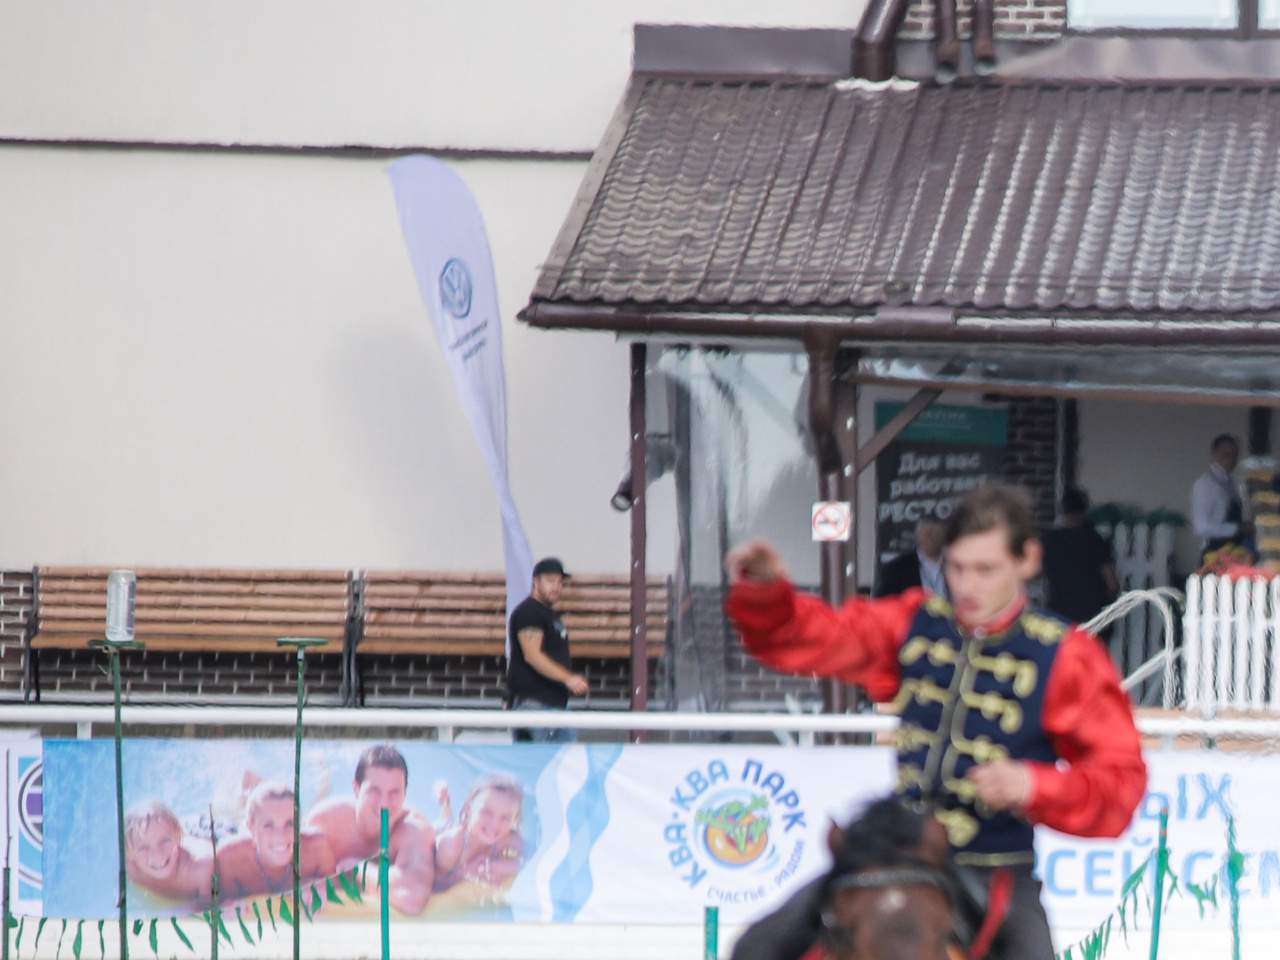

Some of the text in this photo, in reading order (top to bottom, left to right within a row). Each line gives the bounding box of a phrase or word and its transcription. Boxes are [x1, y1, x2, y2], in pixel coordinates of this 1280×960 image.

[898, 452, 941, 475] Для
[878, 498, 960, 522] РЕСТО
[741, 758, 807, 833] ПАРК
[1034, 836, 1164, 897] СЕЙ
